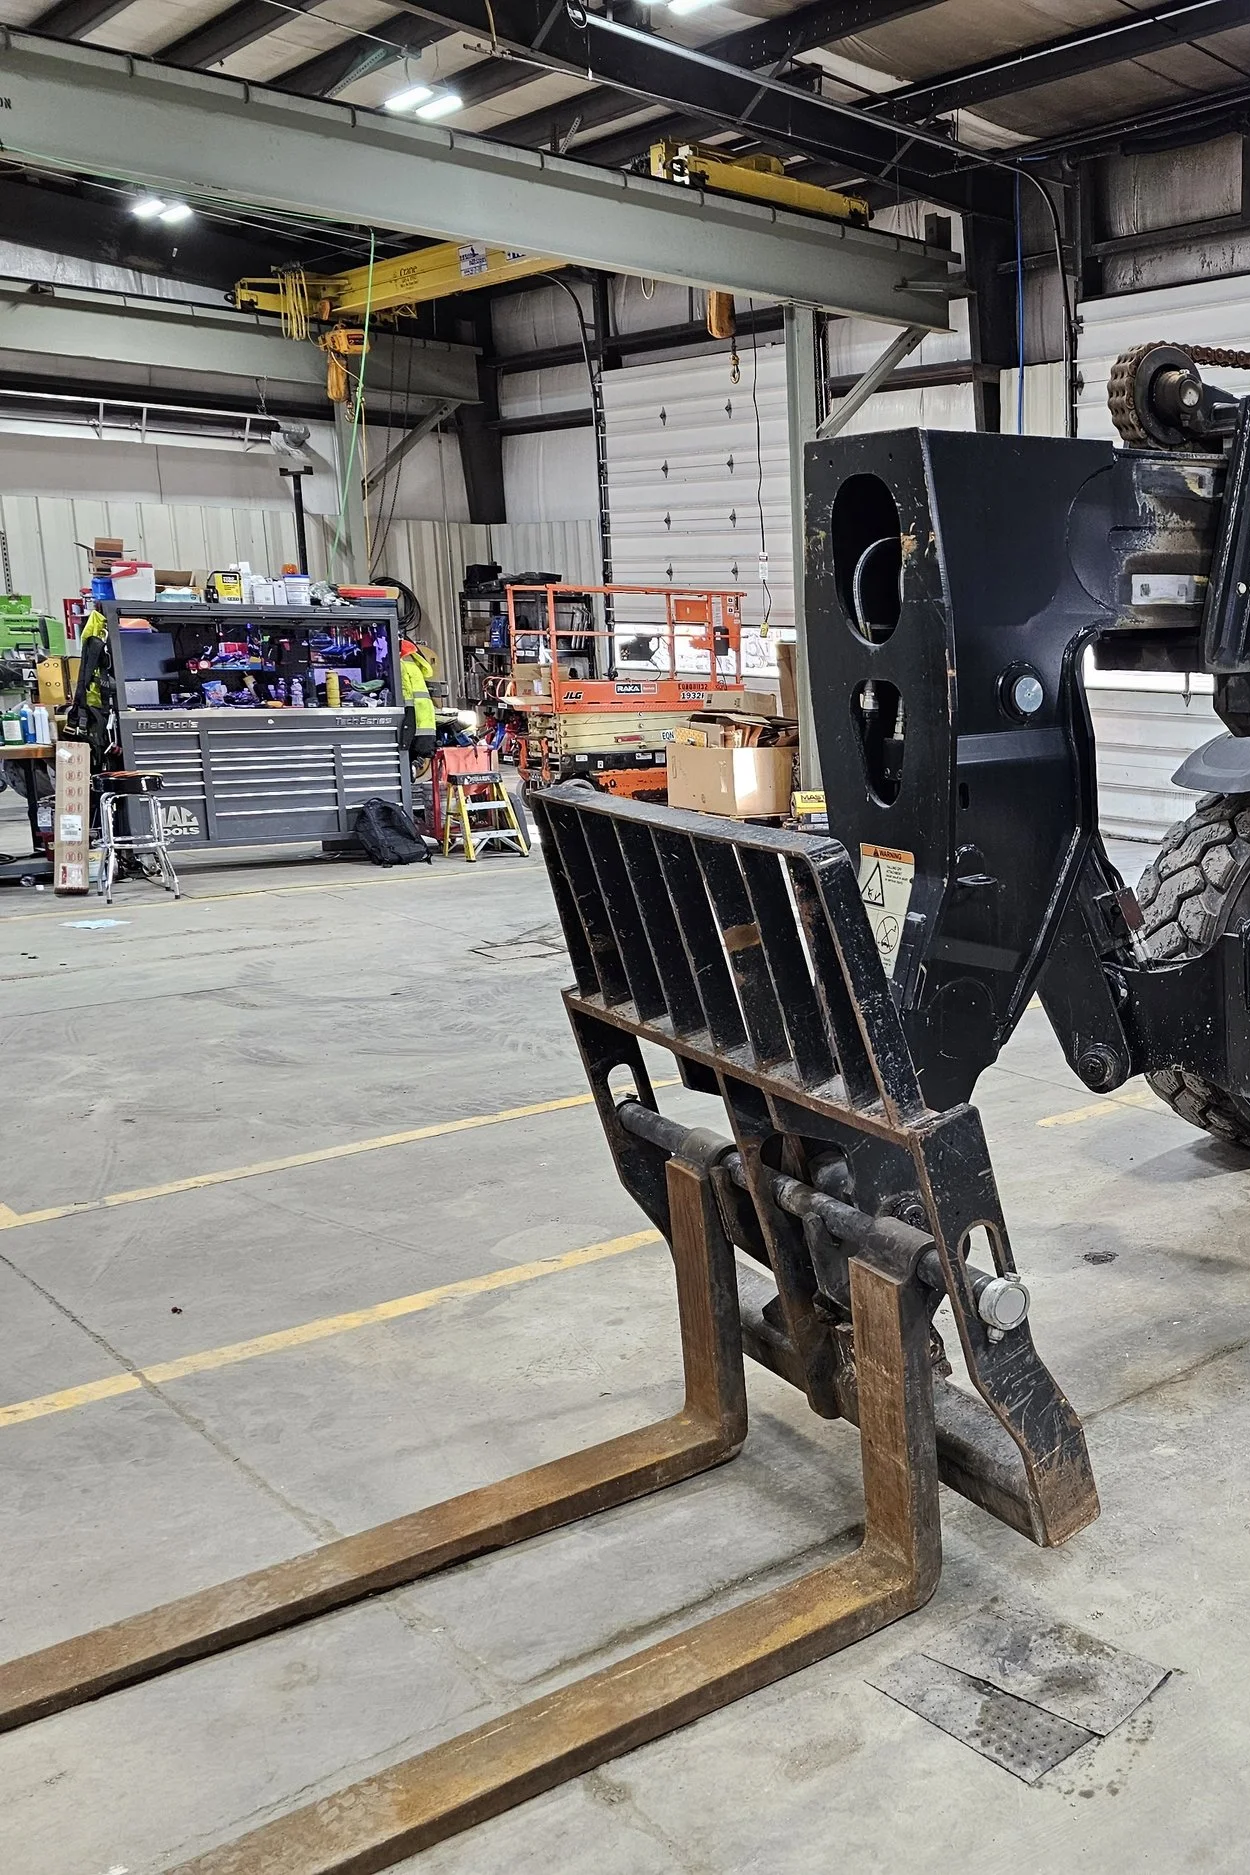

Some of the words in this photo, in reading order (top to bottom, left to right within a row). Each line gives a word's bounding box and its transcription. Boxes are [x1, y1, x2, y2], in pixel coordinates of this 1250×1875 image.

[616, 684, 641, 694] RAKA
[563, 692, 583, 700] JLG
[880, 850, 902, 860] WARNING
